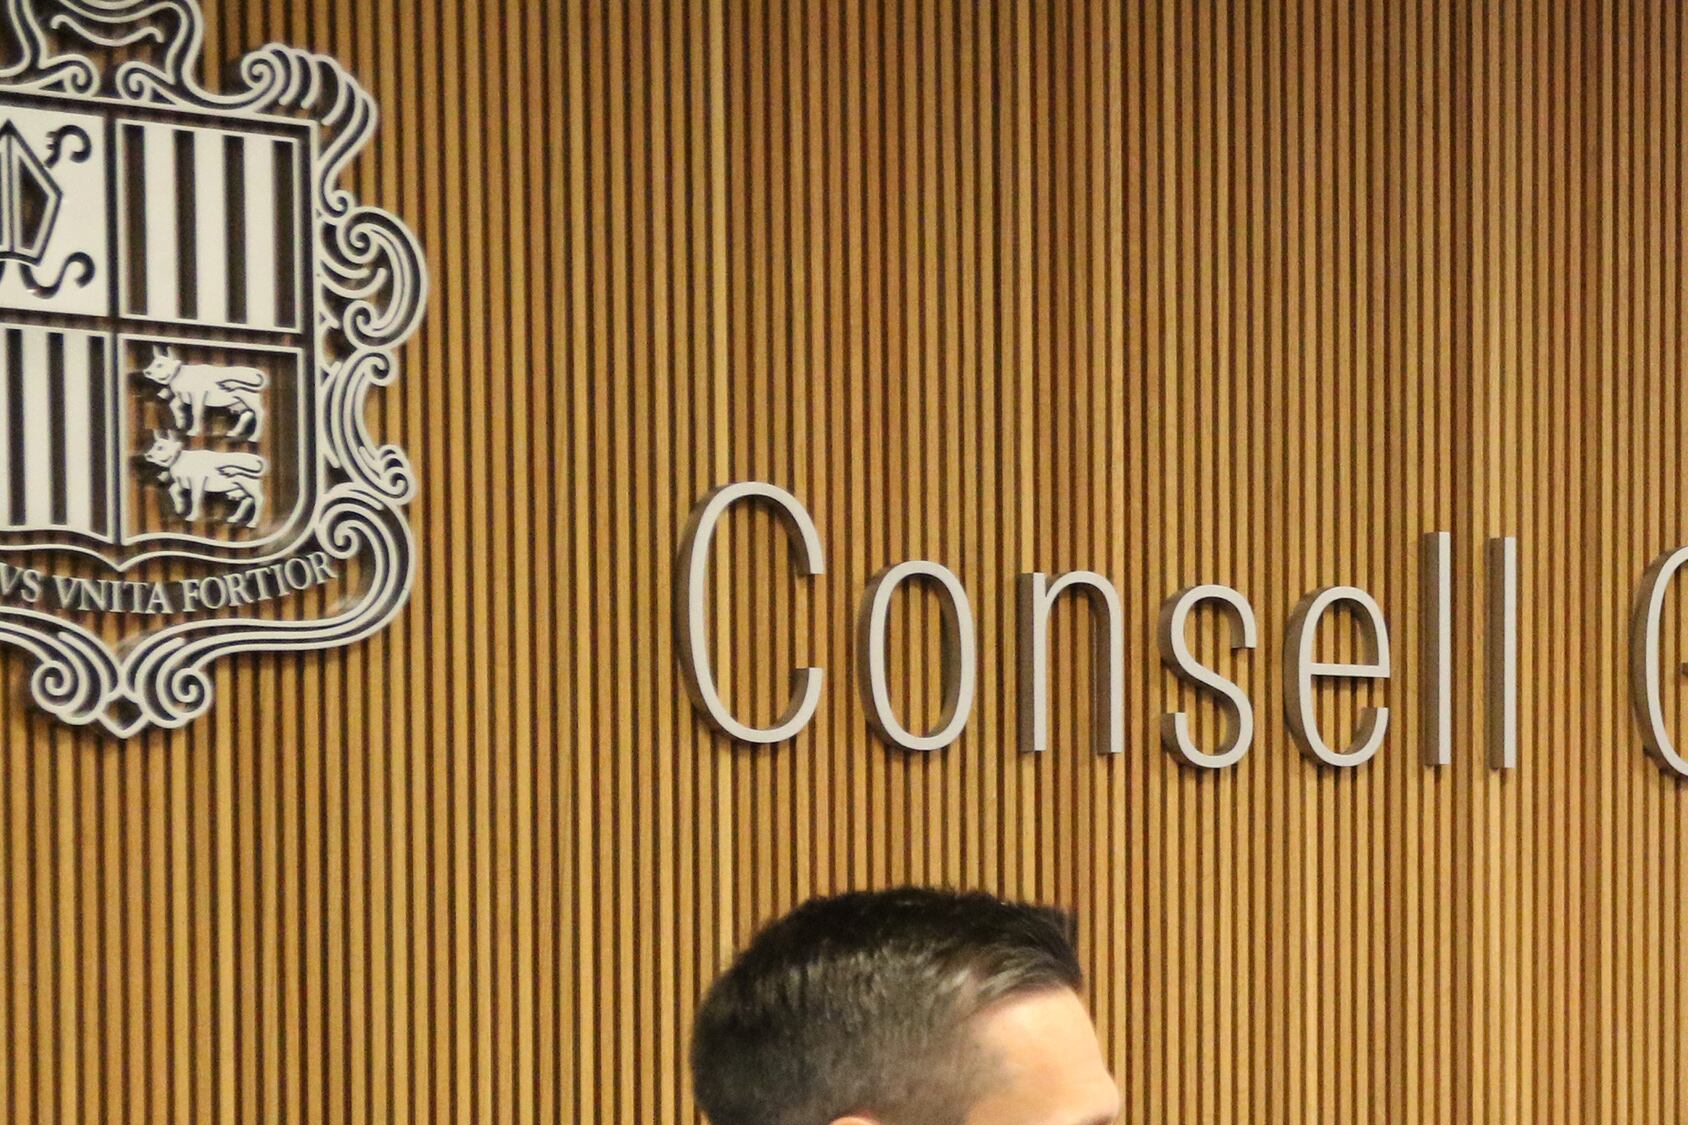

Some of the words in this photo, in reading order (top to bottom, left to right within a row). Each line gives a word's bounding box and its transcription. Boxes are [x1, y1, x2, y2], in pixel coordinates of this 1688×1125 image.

[52, 574, 173, 614] VNITA
[182, 550, 338, 613] FORTIOR
[677, 482, 1516, 770] Consell
